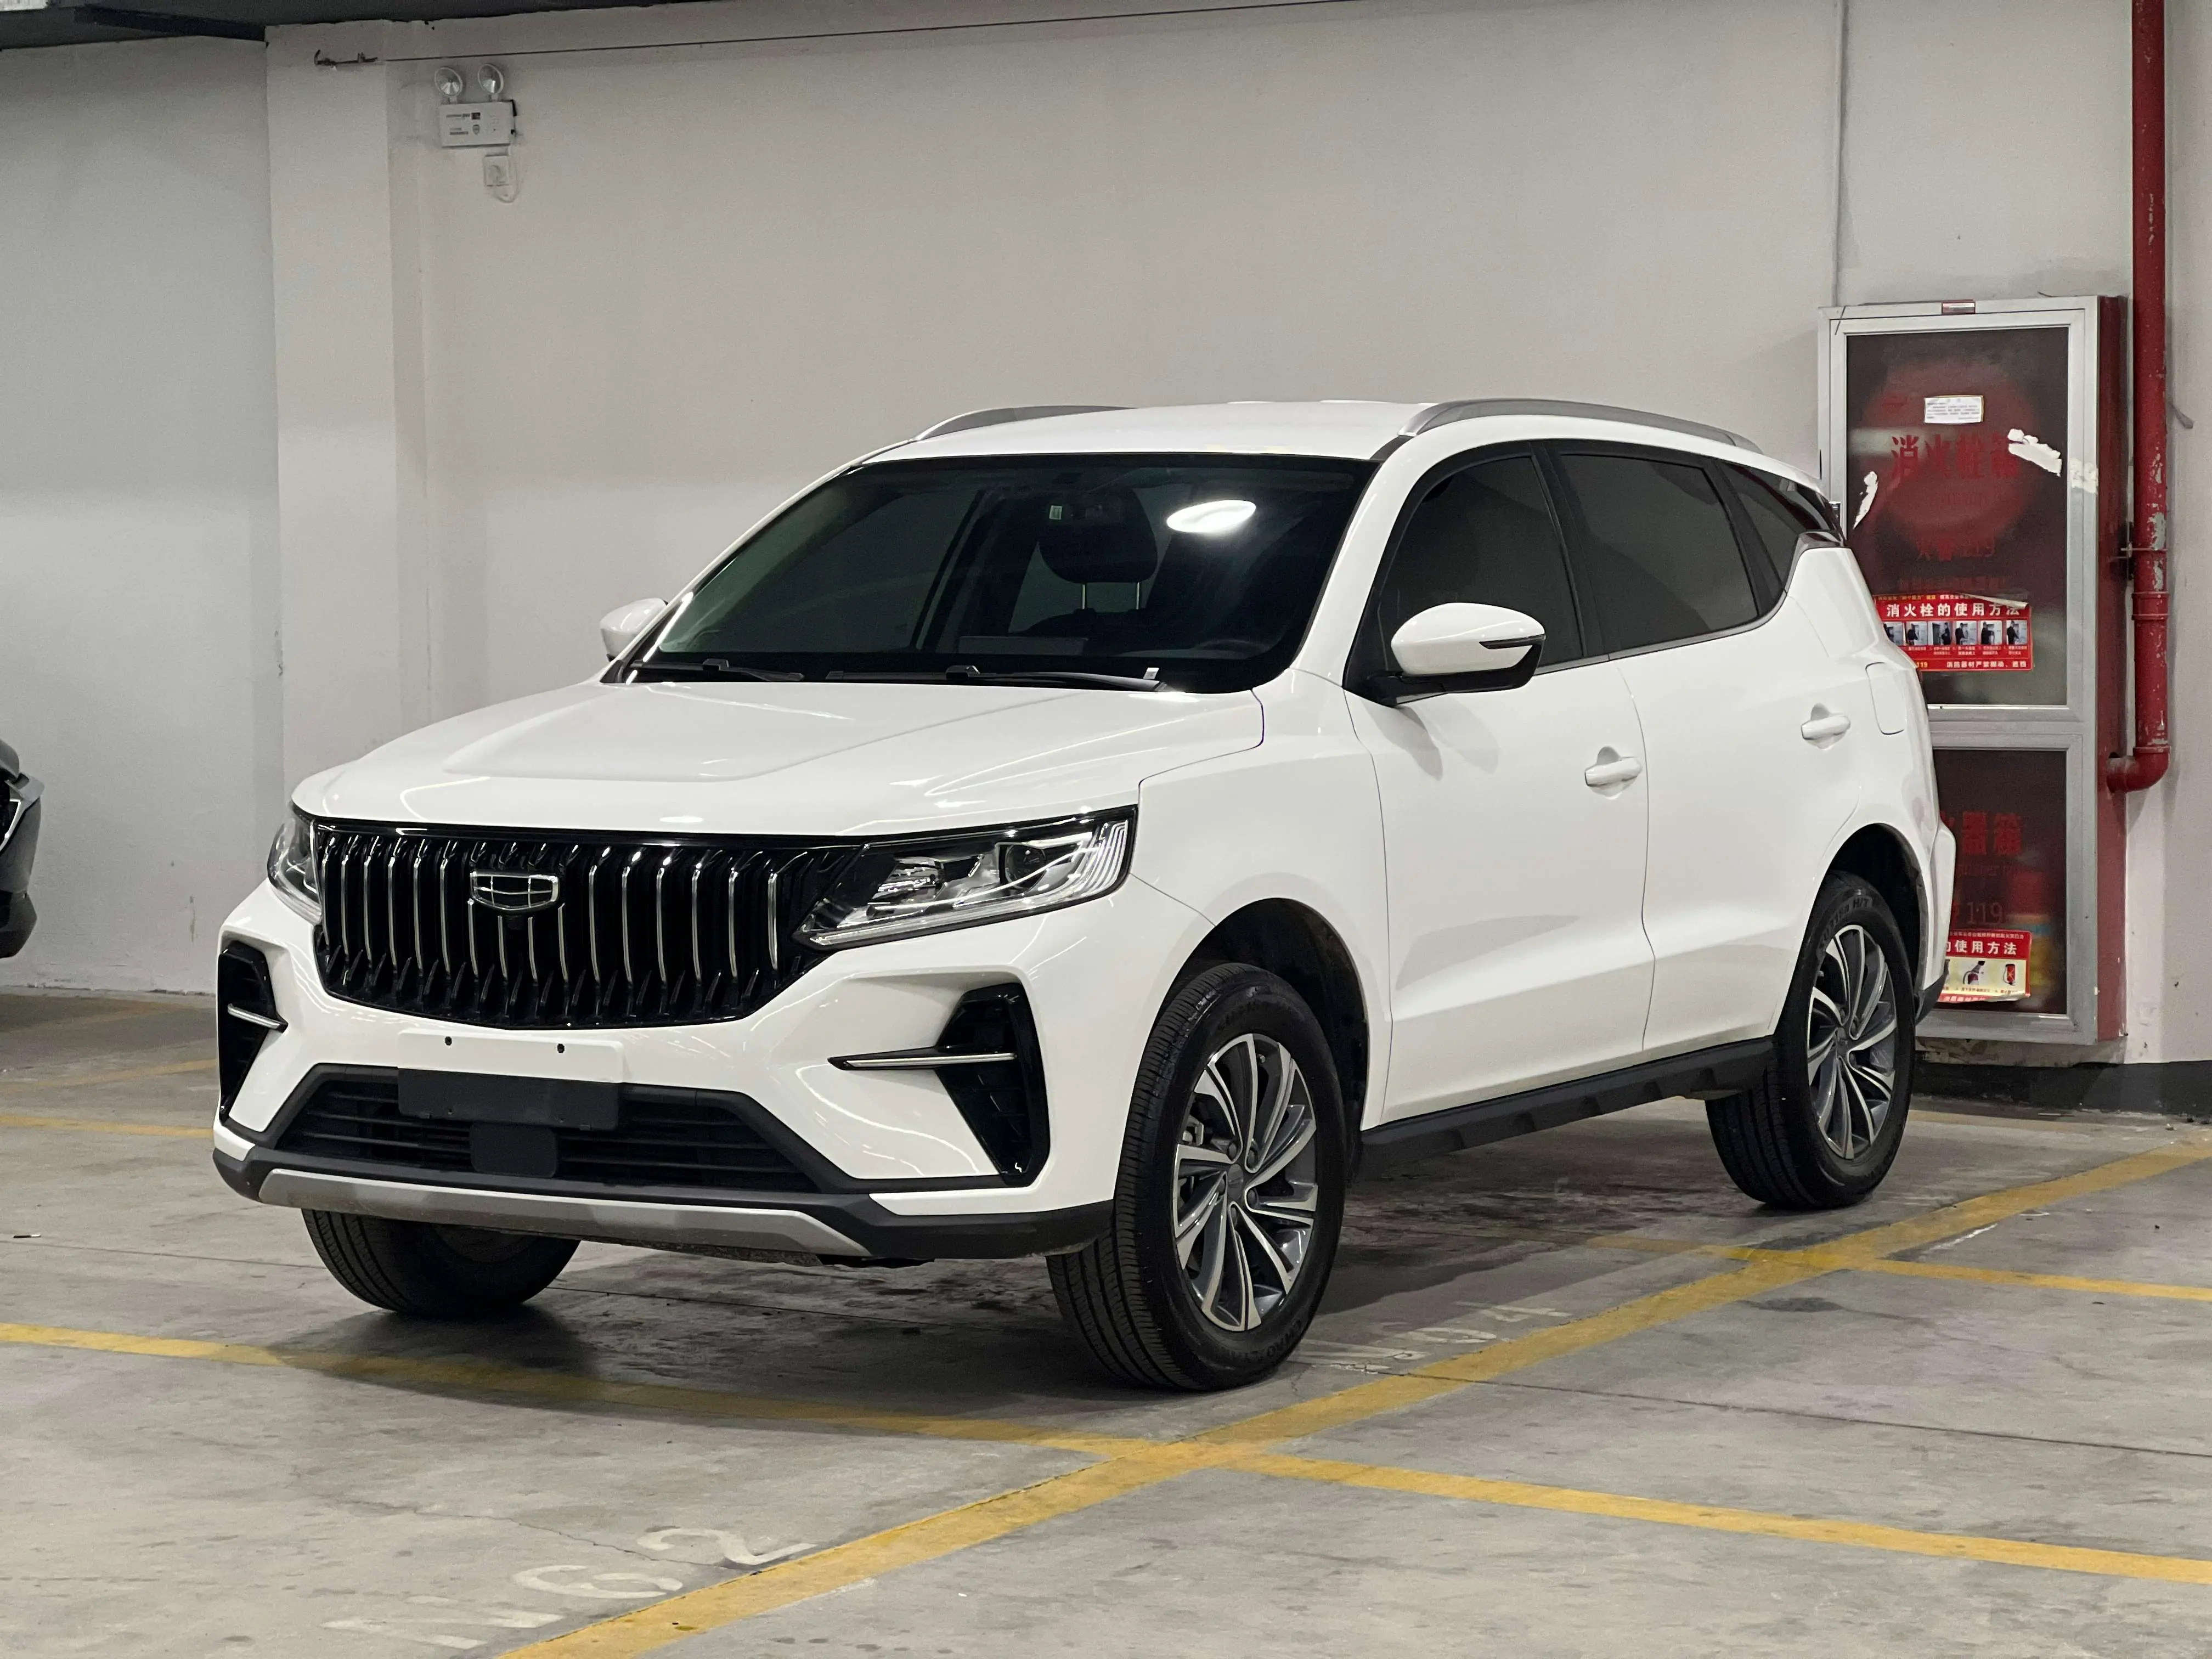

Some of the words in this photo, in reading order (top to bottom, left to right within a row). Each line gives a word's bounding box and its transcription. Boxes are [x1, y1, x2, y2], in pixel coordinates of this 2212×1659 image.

[1887, 602, 2020, 618] 消火栓的使用方法
